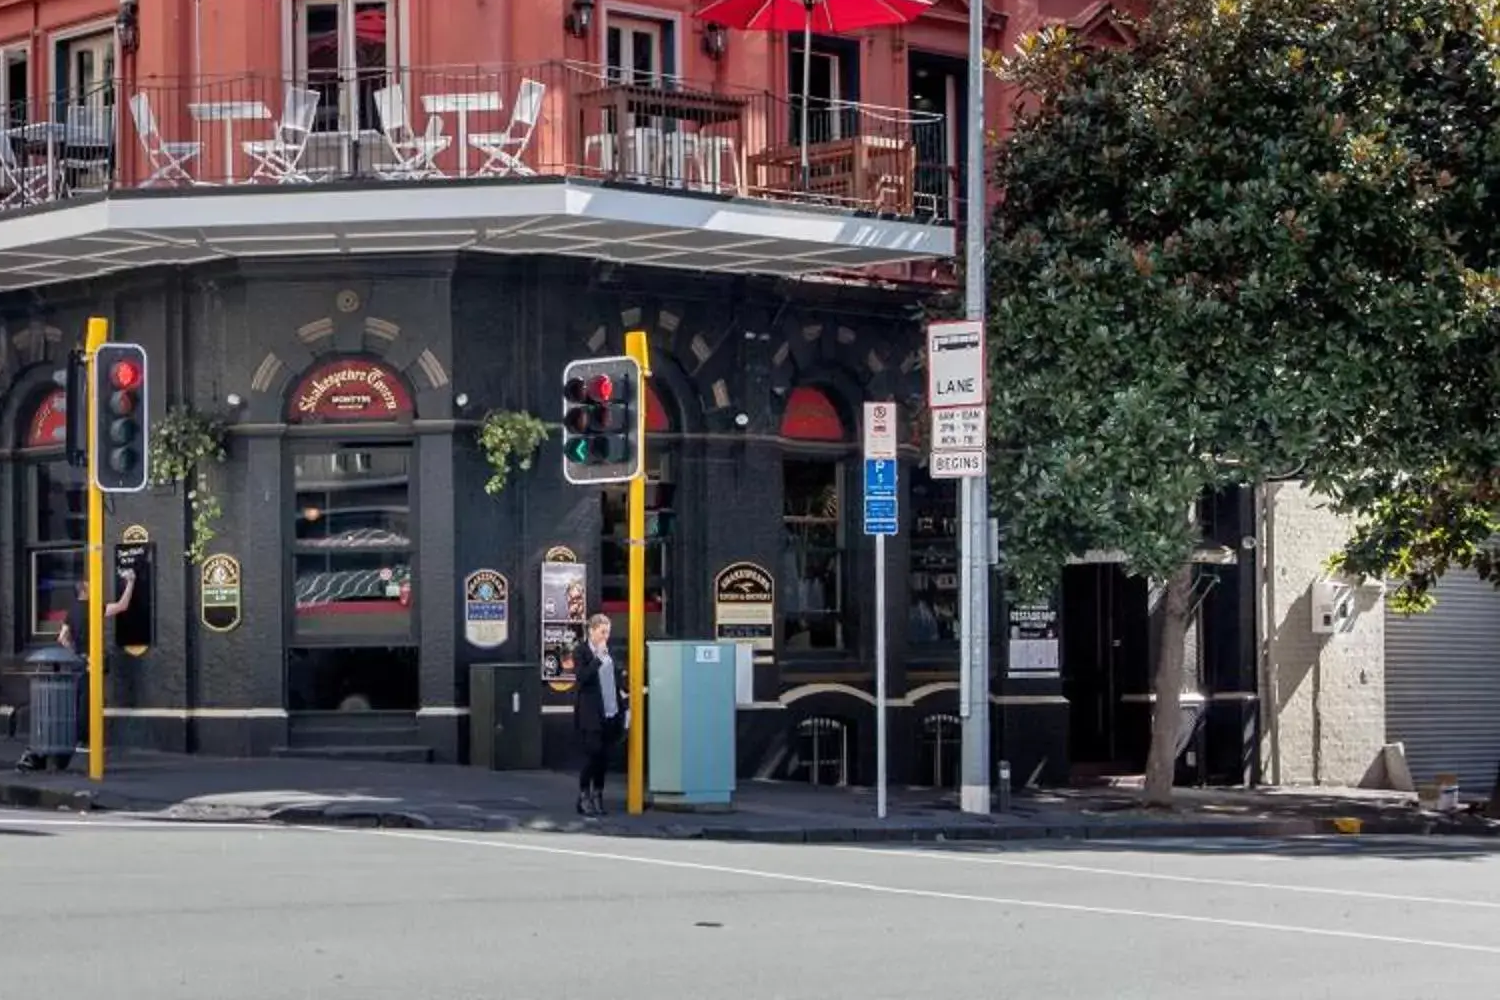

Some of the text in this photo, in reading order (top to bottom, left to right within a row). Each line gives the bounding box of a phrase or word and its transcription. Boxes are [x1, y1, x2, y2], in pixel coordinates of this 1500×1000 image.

[299, 367, 397, 413] Shakespeare Tavern
[936, 378, 975, 395] LANE
[936, 456, 979, 471] BEGINS
